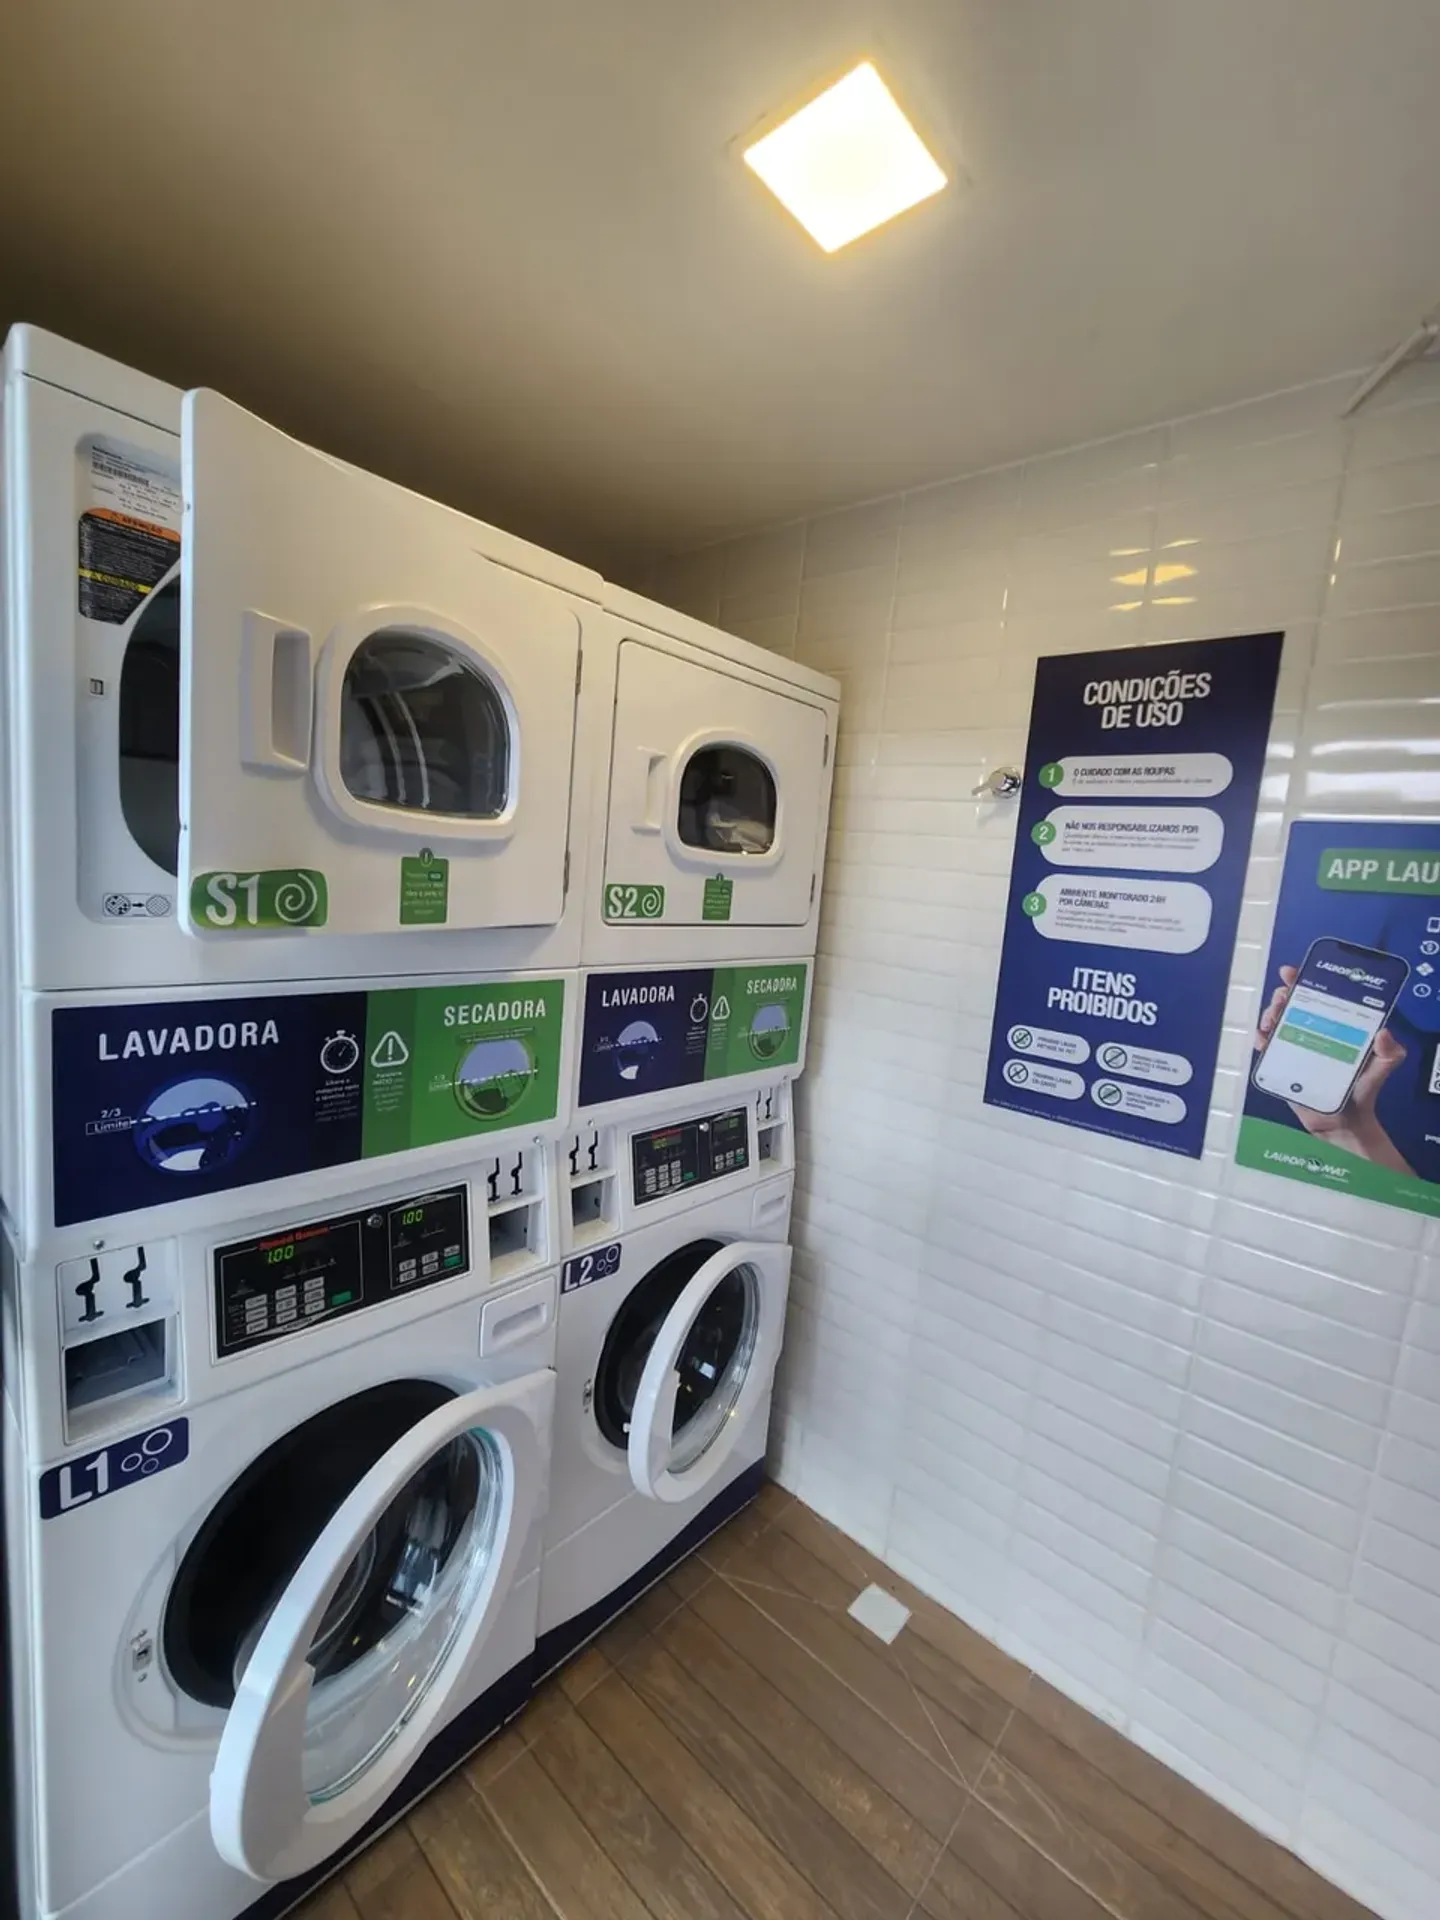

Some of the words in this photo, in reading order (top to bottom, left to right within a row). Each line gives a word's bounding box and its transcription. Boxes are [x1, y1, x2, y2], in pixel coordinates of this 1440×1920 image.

[1083, 669, 1212, 705] CONDIÇÕES
[1101, 704, 1132, 729] DE
[1136, 701, 1184, 727] USO
[1048, 767, 1056, 782] 1
[1113, 768, 1131, 776] COM
[1039, 825, 1049, 840] 2
[1327, 858, 1379, 880] APP
[205, 873, 260, 926] S1
[608, 886, 639, 917] S2
[1030, 896, 1040, 912] 3
[602, 985, 675, 1007] LAVADORA
[747, 977, 797, 994] SECADORA
[1072, 966, 1136, 997] ITENS
[444, 998, 546, 1027] SECADORA
[1047, 987, 1158, 1026] PROIBIDOS
[99, 1020, 280, 1061] LAVADORA
[564, 1256, 594, 1291] L2
[59, 1451, 109, 1510] L1
